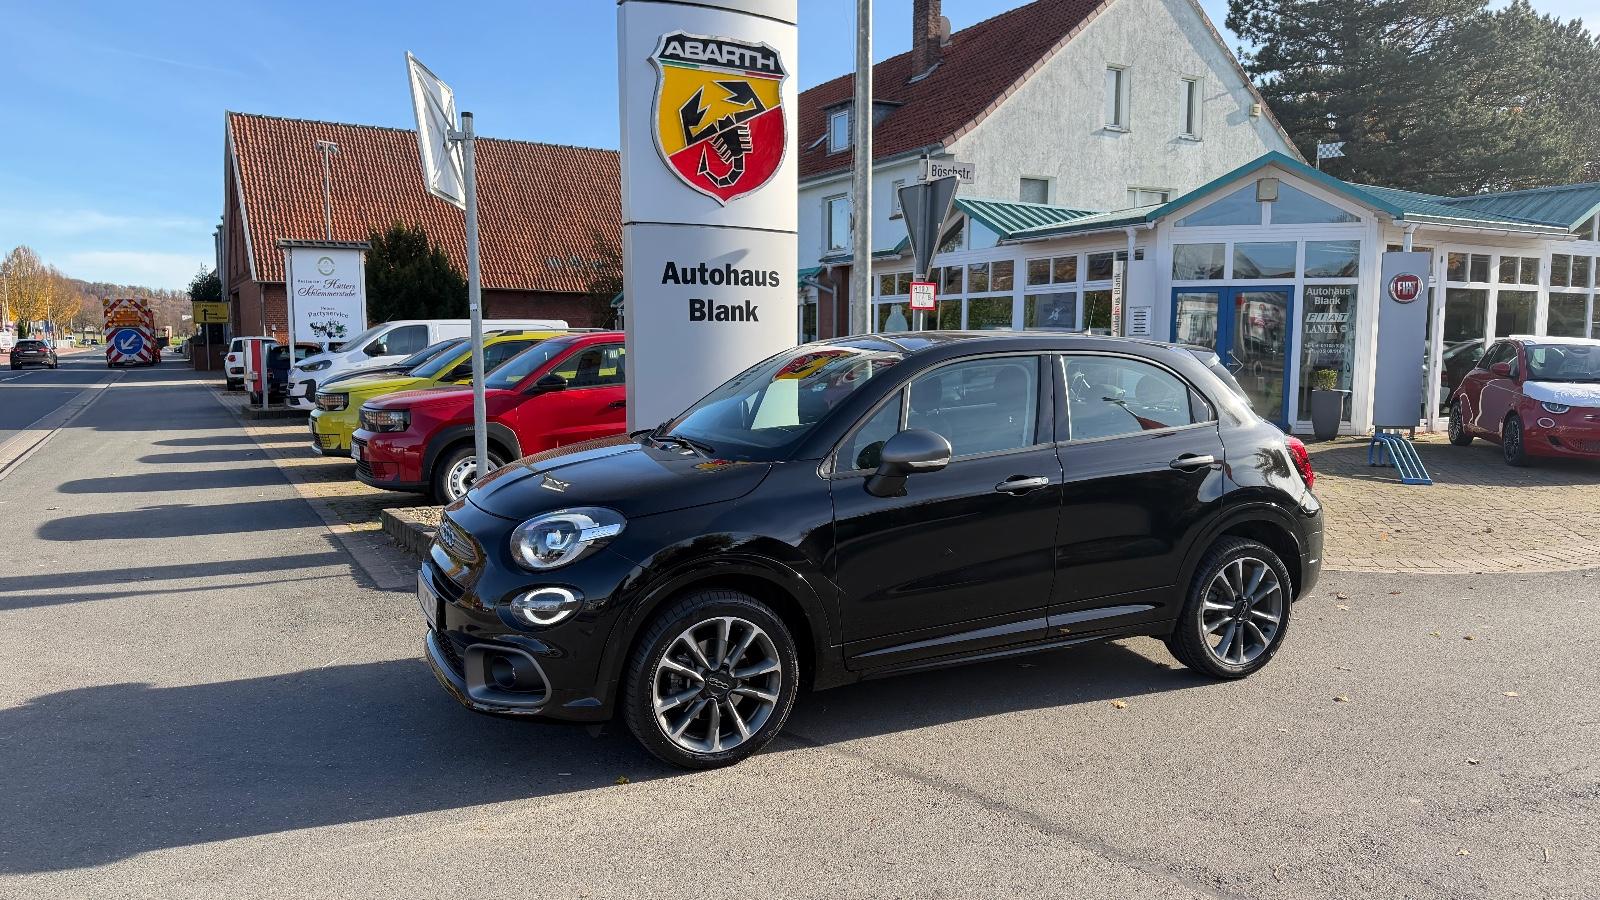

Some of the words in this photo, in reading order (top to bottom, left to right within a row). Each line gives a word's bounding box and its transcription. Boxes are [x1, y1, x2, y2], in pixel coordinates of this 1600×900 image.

[664, 41, 775, 70] ABARTH
[931, 164, 972, 180] Böschstr.
[661, 261, 780, 287] Autohaus
[1113, 273, 1122, 295] Blank
[1306, 287, 1351, 296] Autohaus
[1397, 281, 1418, 295] FIAT
[1314, 296, 1341, 305] Blank
[689, 298, 759, 322] Blank
[1112, 298, 1121, 334] Autohaus
[1305, 312, 1350, 323] FIAT
[1304, 324, 1338, 334] LANCIA
